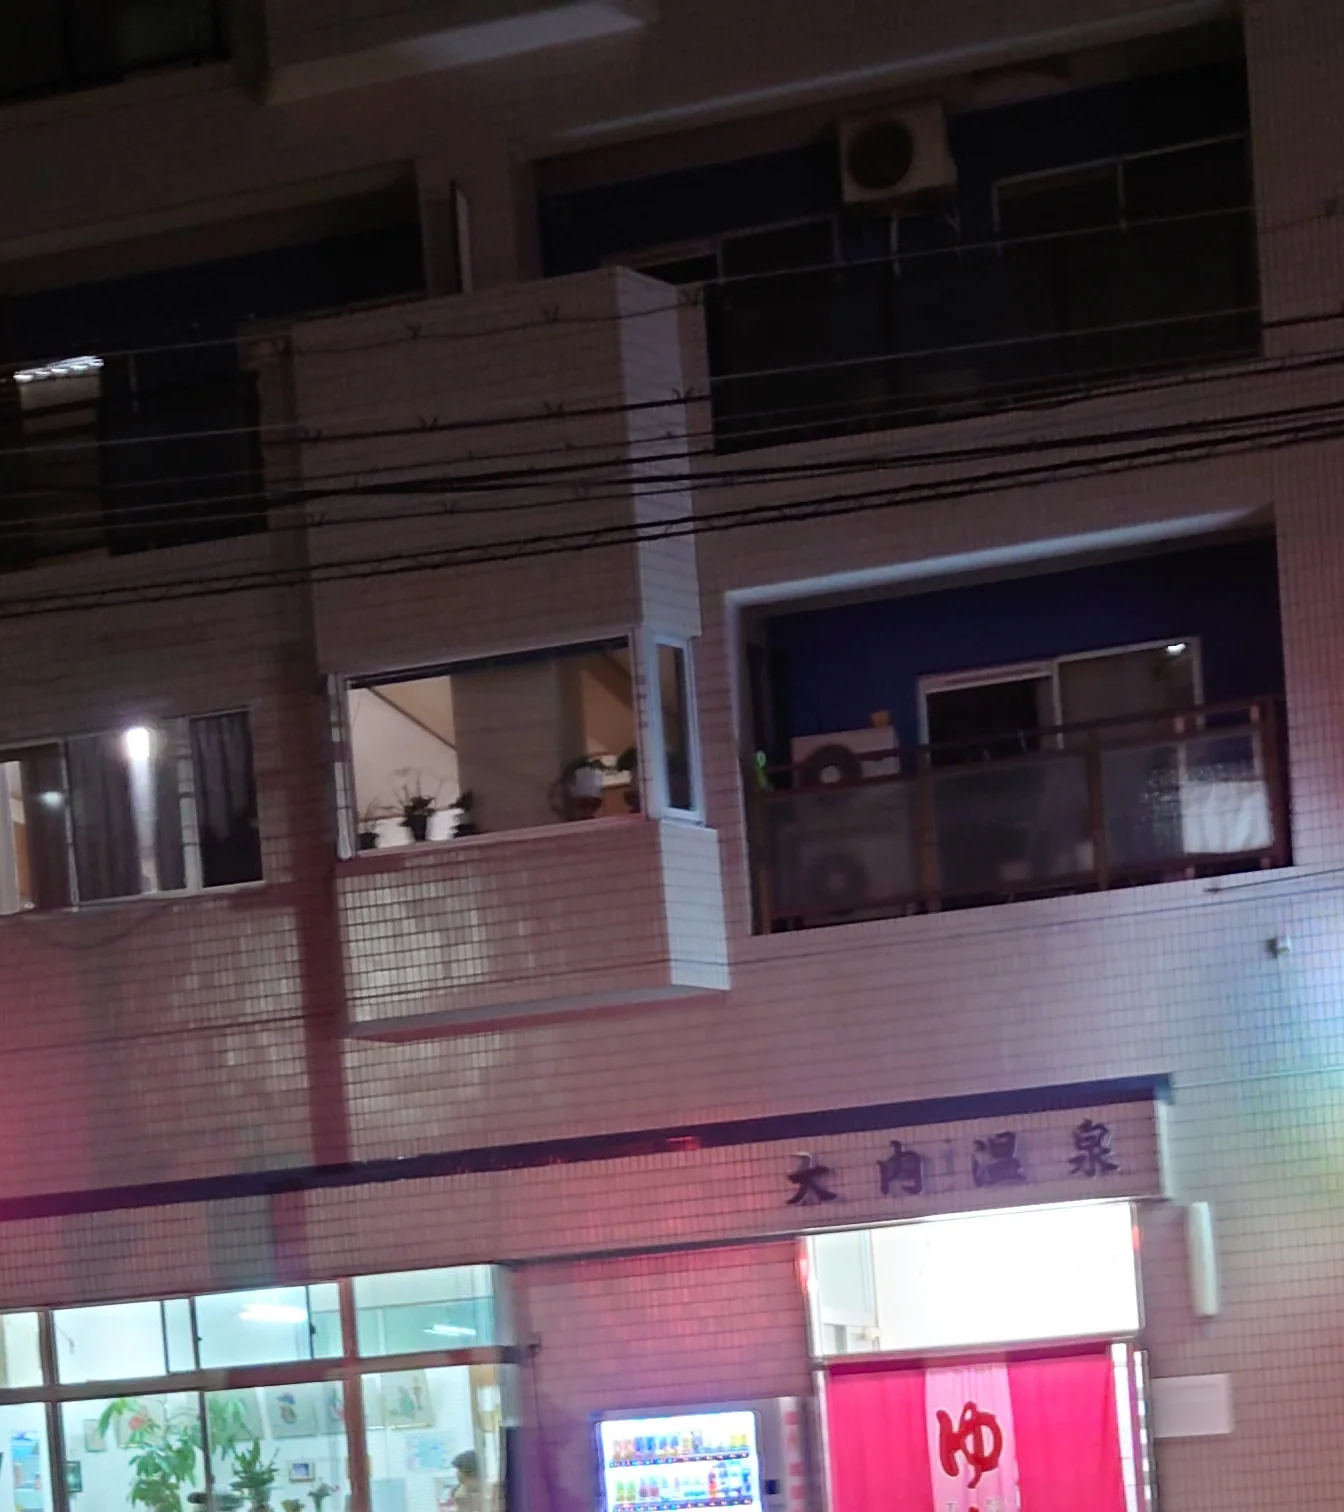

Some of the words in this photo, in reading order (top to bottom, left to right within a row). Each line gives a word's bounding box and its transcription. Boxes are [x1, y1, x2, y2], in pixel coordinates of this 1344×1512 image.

[786, 1118, 1120, 1206] 大内温泉
[936, 1401, 1003, 1489] ゆ
